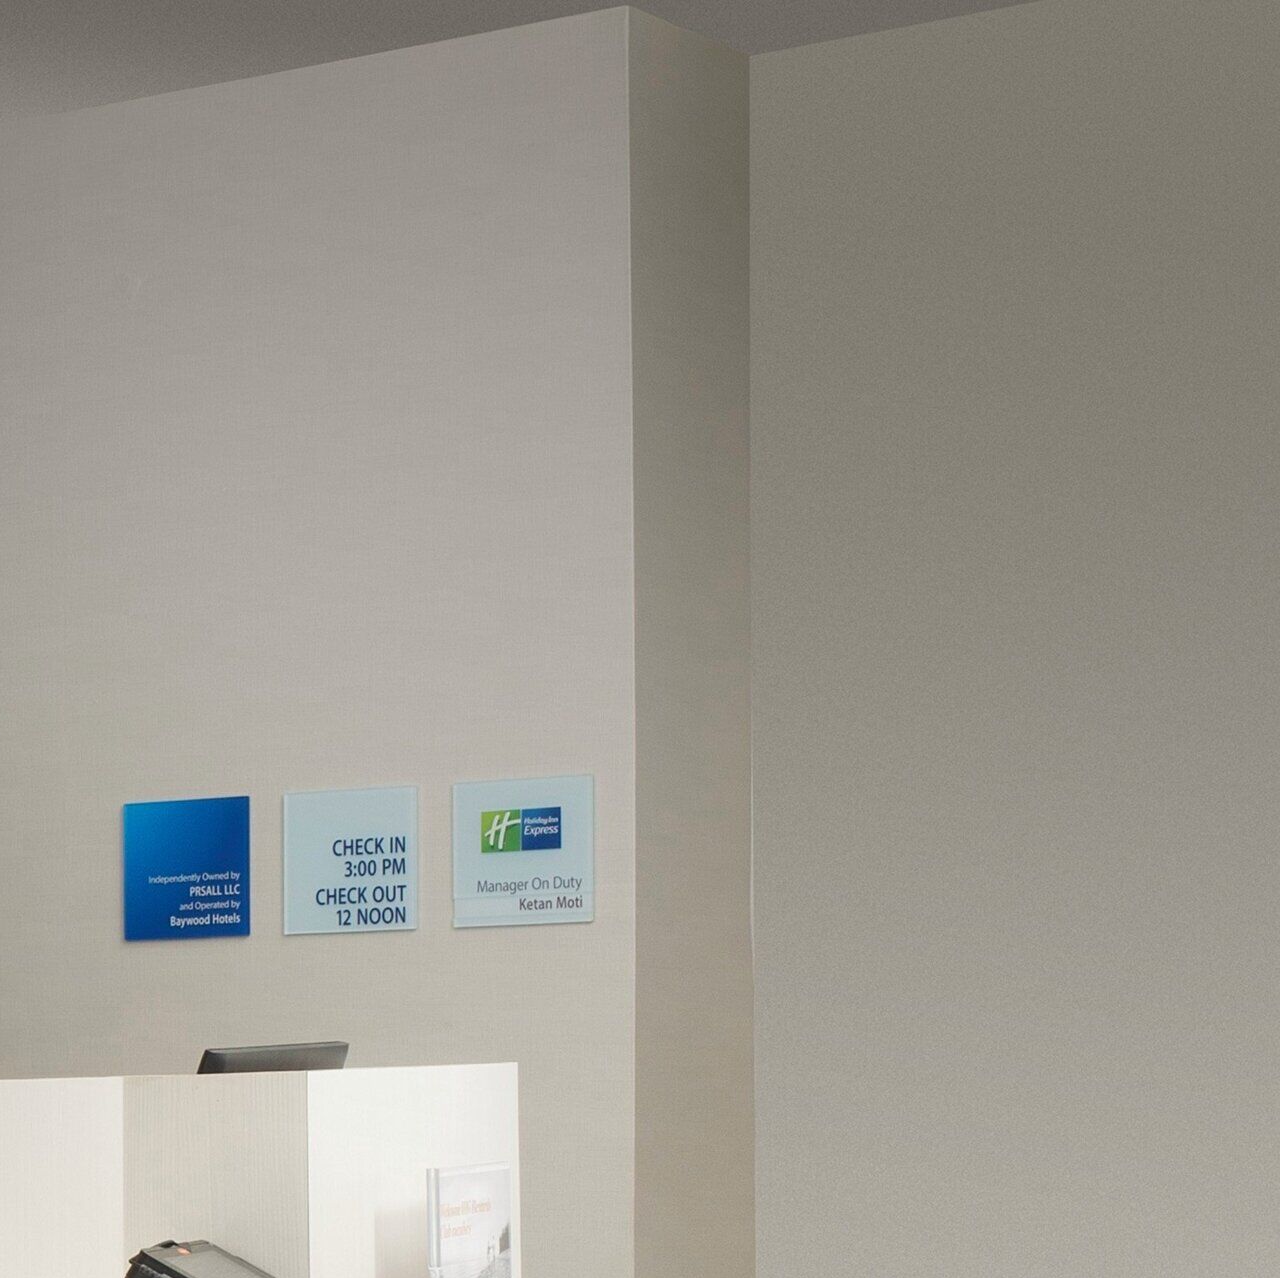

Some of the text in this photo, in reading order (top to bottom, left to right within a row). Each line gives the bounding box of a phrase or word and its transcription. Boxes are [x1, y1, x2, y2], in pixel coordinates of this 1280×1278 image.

[524, 825, 559, 837] Express
[332, 836, 406, 856] CHECK IN
[344, 858, 406, 877] 3:00 PM
[148, 871, 240, 885] Independently Owned by
[477, 876, 582, 895] Manager On Duty
[189, 884, 240, 897] PRSALL LLC
[316, 885, 407, 906] CHECK OUT
[179, 900, 240, 911] and Operated by
[519, 895, 583, 911] Ketan Moti
[170, 913, 240, 928] Baywood Hotels
[336, 906, 406, 926] 12 NOON
